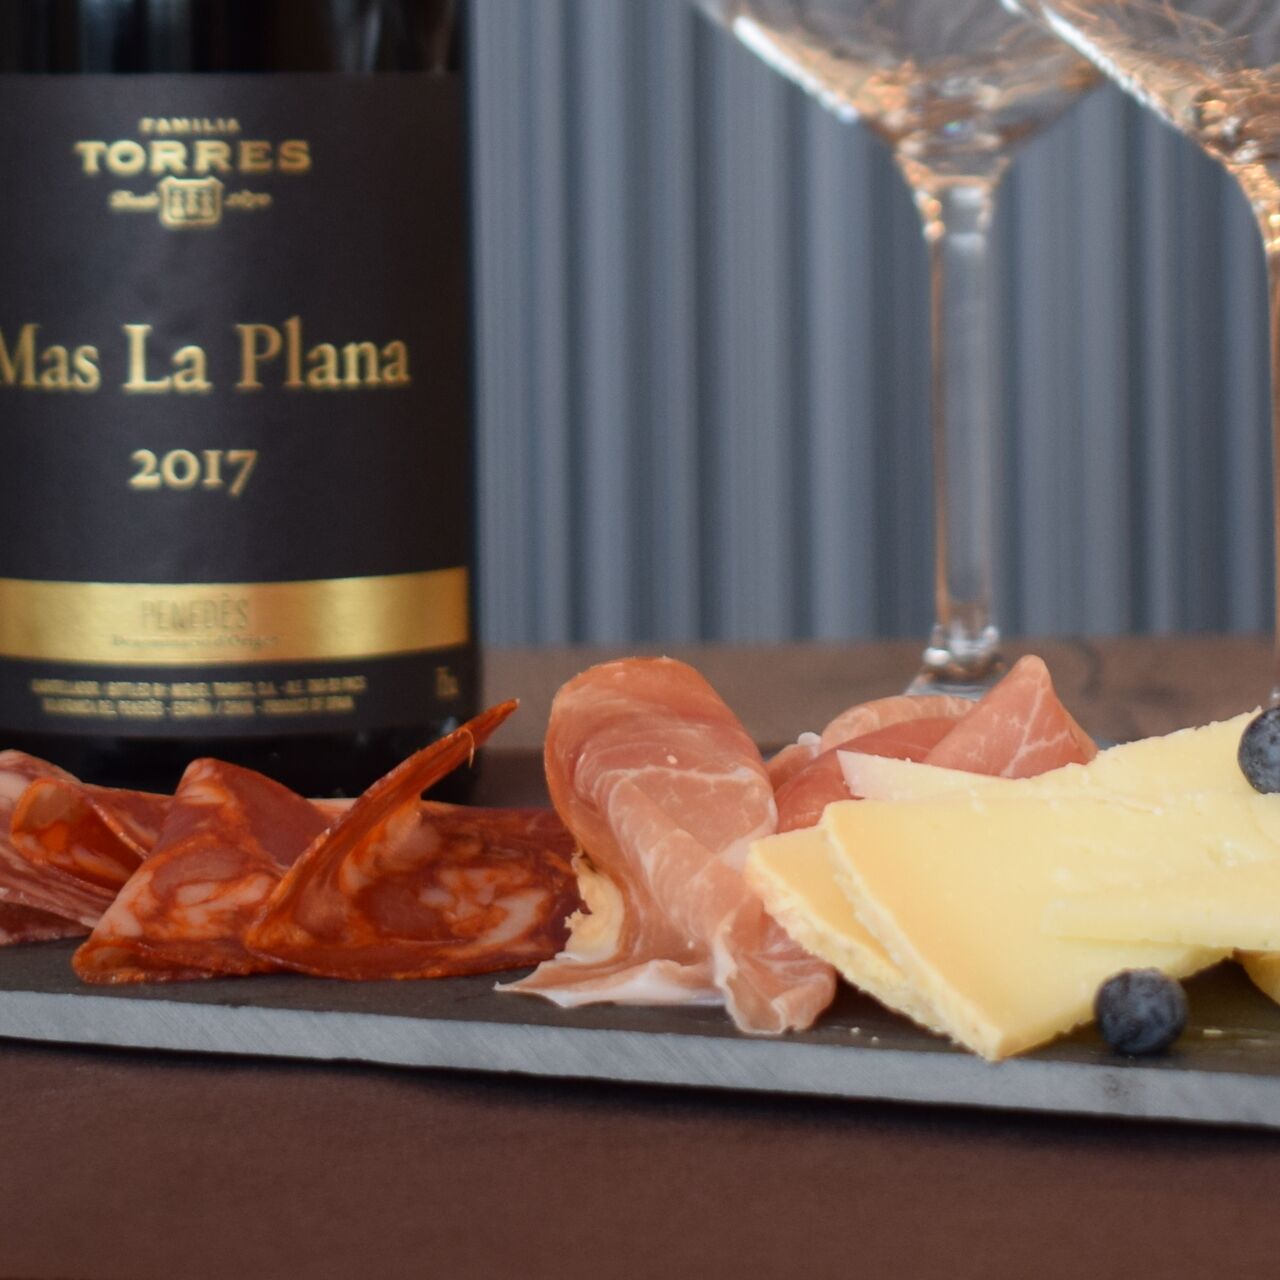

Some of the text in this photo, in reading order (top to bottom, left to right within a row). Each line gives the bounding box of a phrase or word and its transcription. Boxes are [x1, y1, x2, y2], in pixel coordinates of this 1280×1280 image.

[140, 118, 240, 134] FAMILIA
[75, 140, 311, 175] TORRES
[123, 323, 212, 393] La
[236, 316, 410, 392] Plana
[129, 448, 257, 496] 2017
